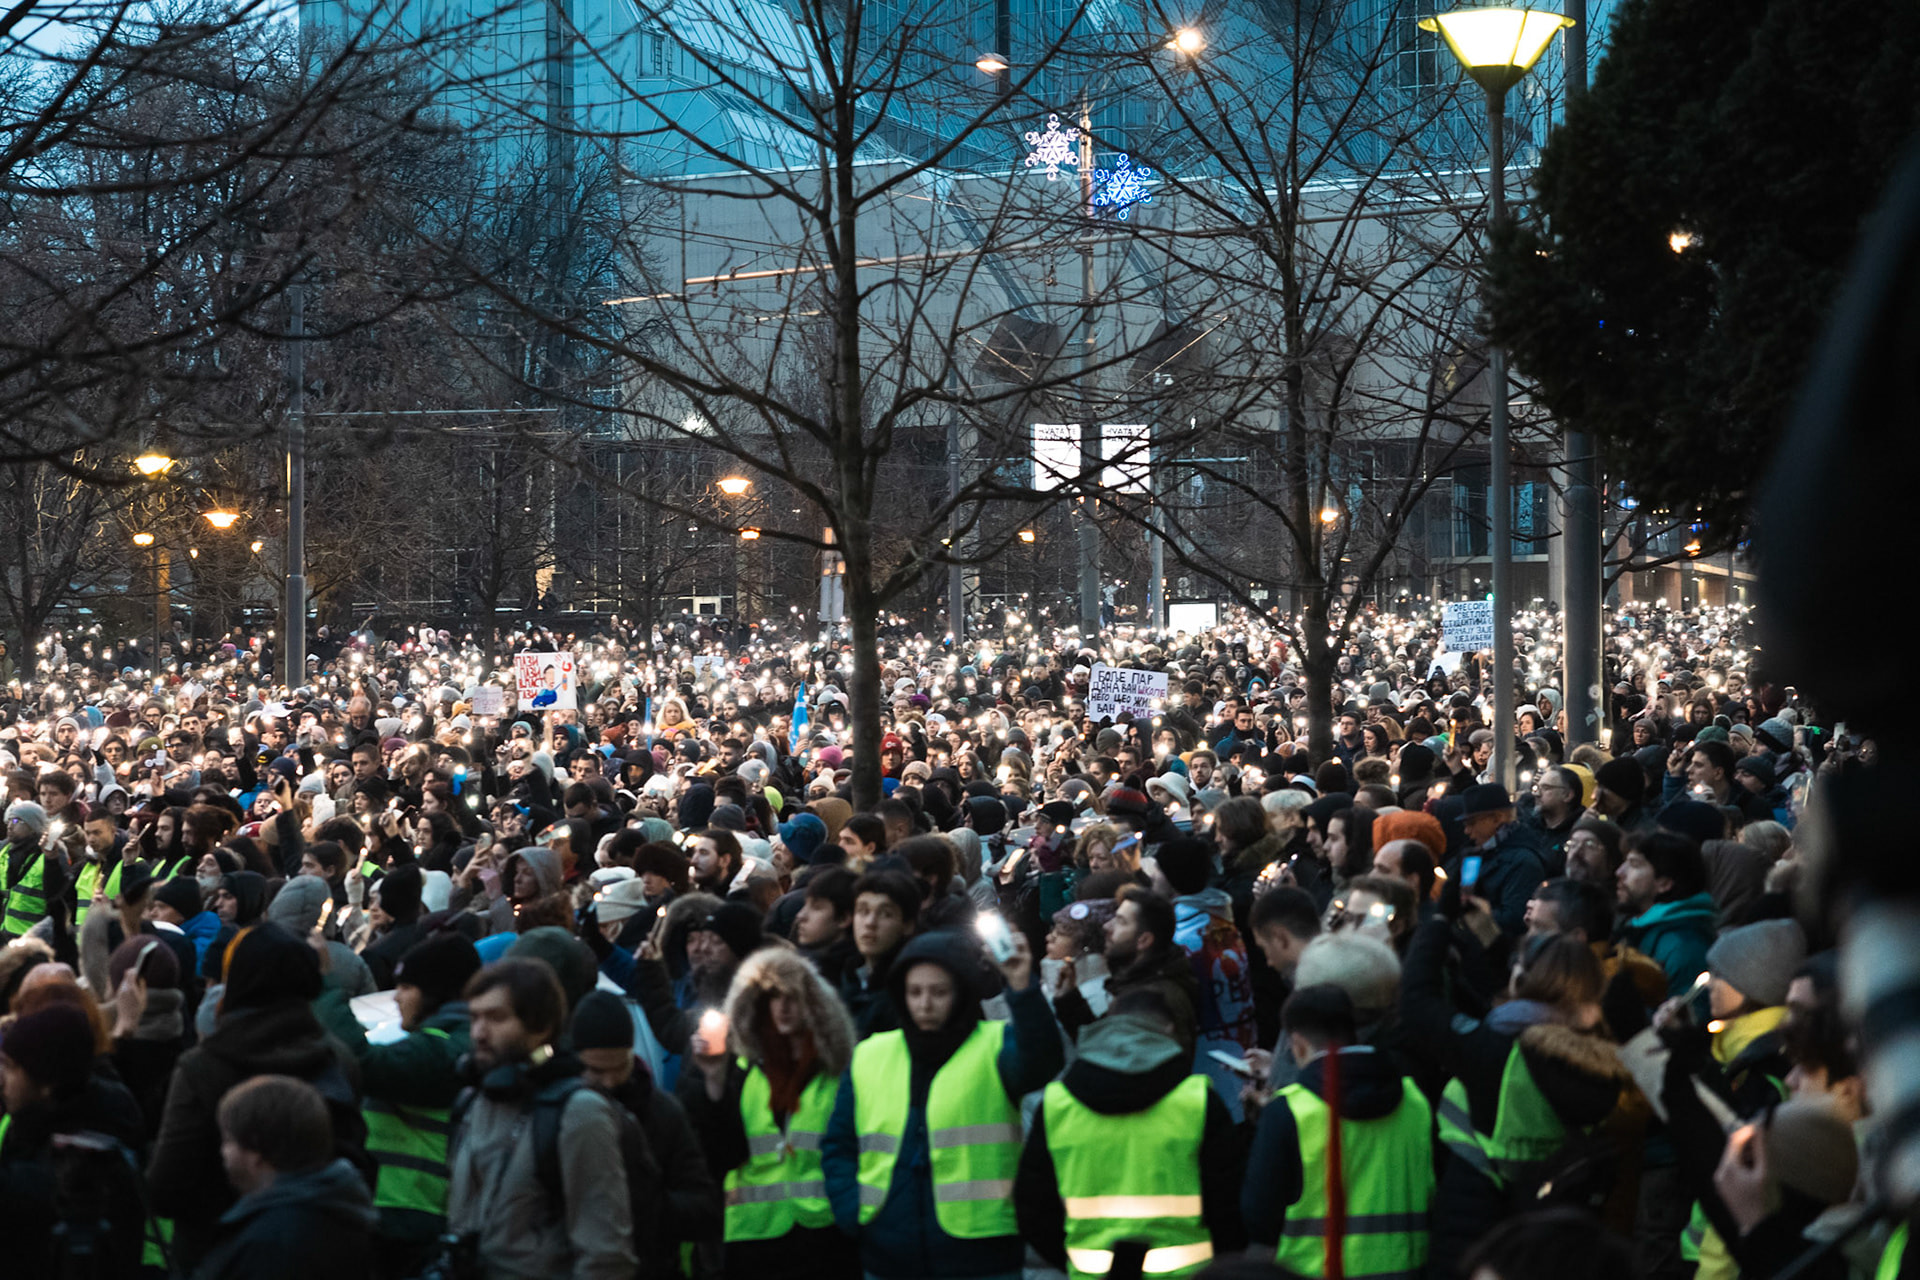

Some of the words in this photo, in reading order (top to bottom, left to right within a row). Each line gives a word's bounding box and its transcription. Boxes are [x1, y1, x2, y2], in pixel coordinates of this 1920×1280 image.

[1098, 670, 1126, 683] БОЉЕ
[1131, 672, 1154, 686] ПАР
[1091, 681, 1120, 694] ДАНА
[1137, 685, 1166, 698] ШКОЛЕ
[1091, 693, 1111, 702] НЕГО
[1113, 693, 1132, 705] ЦЕО
